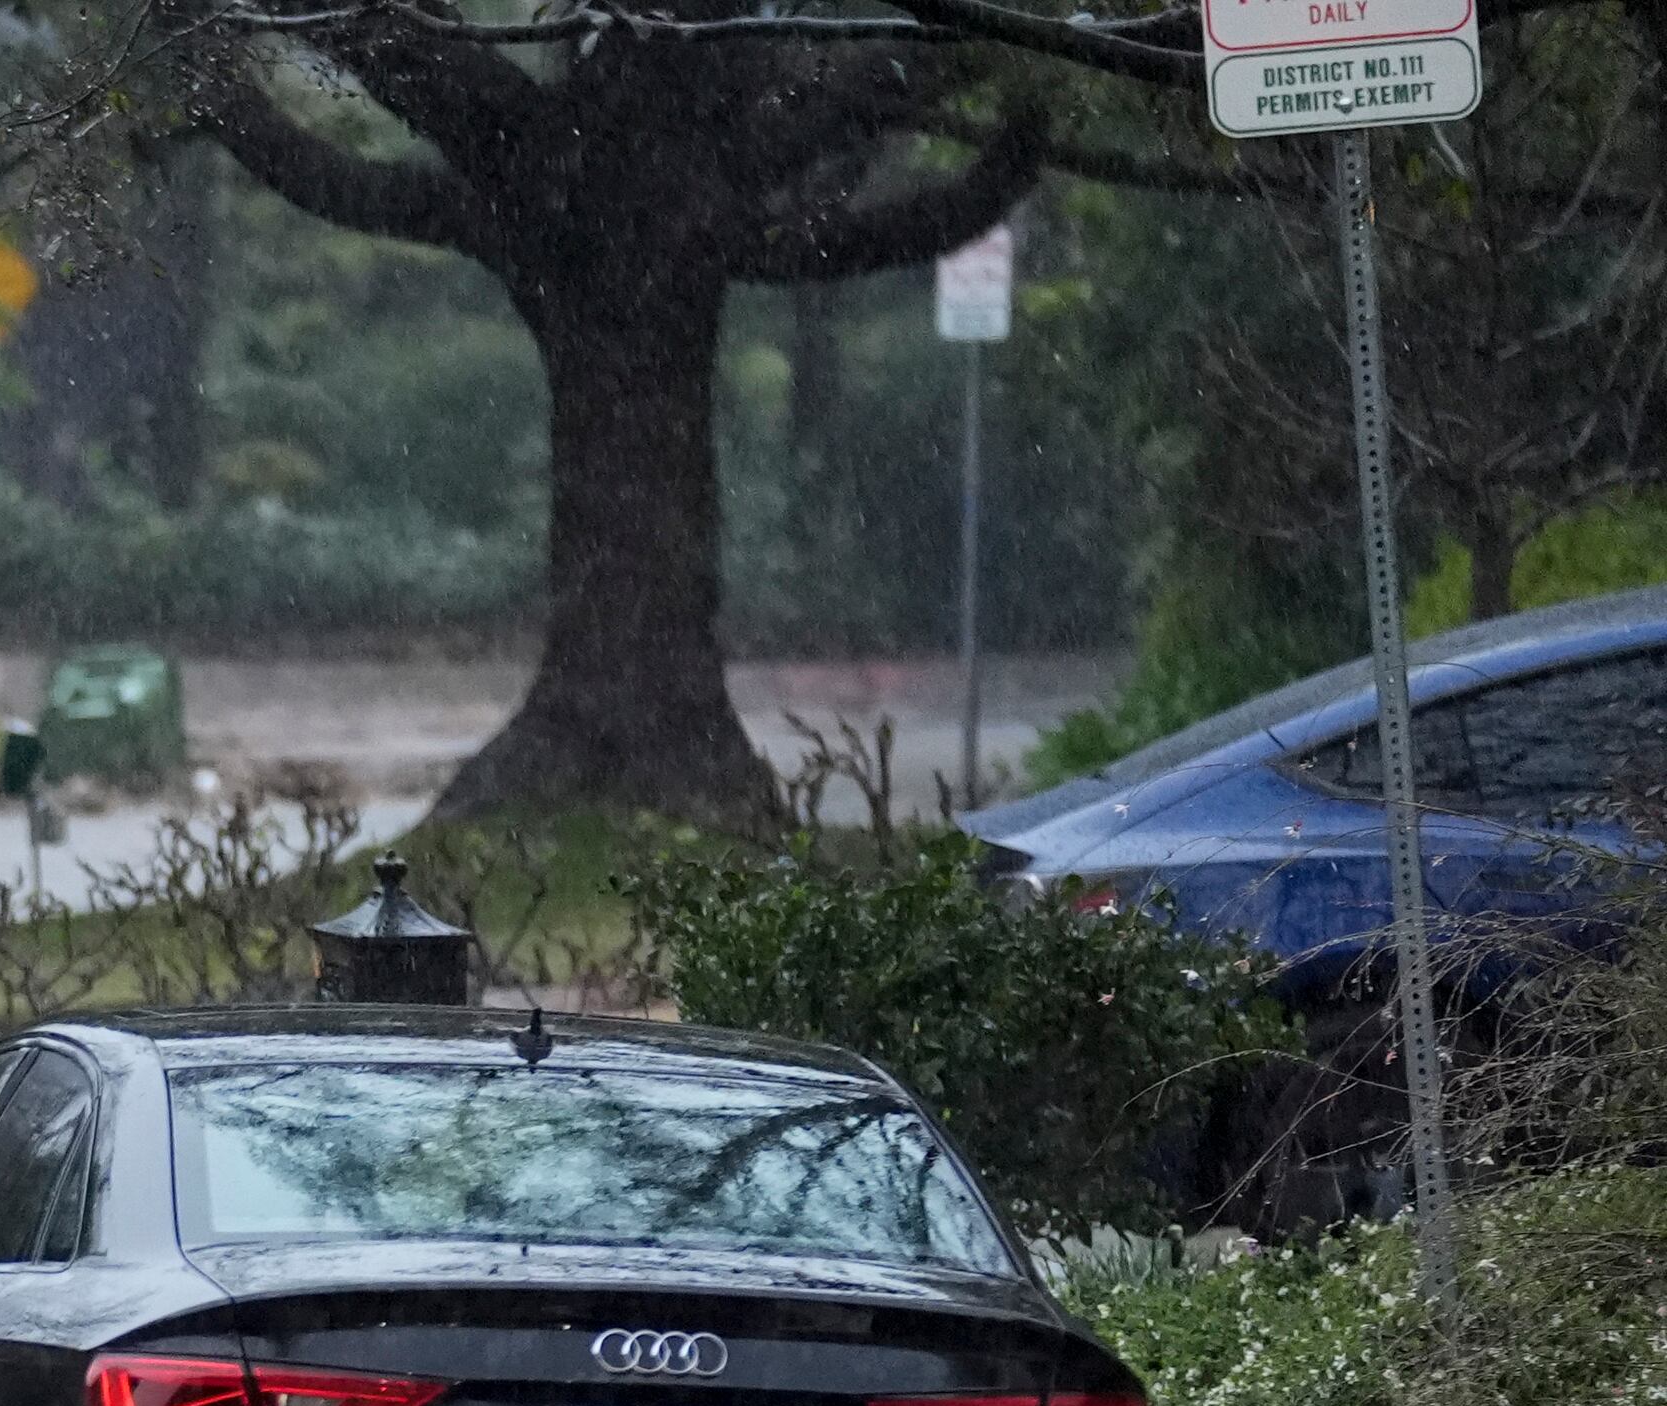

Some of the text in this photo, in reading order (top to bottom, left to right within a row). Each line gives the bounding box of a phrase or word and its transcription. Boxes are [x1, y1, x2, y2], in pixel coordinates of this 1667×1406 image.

[1309, 2, 1367, 25] DAILY
[1263, 61, 1355, 88] DISTRICT
[1256, 82, 1436, 116] PERMITS EXEMPT
